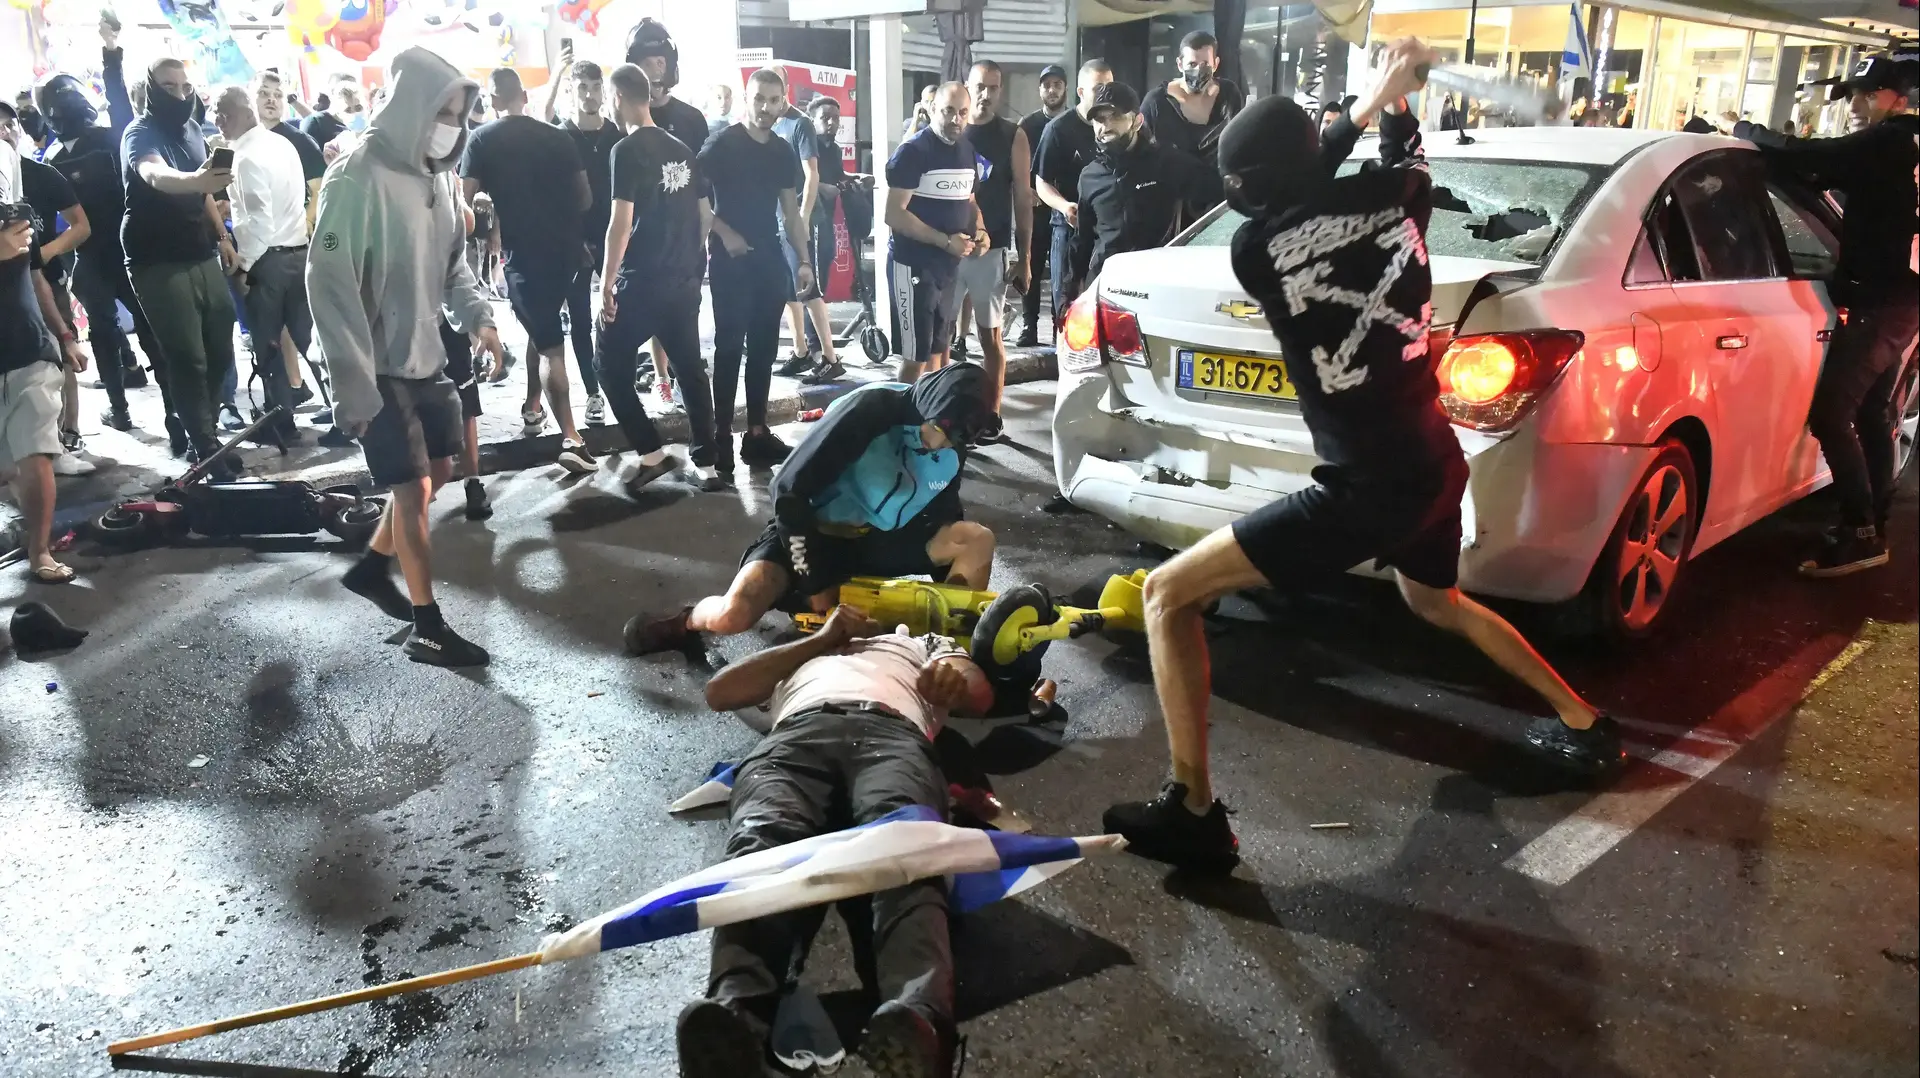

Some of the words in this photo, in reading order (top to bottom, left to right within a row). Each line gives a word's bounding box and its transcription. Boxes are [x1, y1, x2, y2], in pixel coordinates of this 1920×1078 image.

[817, 71, 838, 85] ATM
[936, 180, 973, 190] GANT
[900, 289, 909, 331] GANT
[1182, 362, 1191, 376] IL
[418, 637, 442, 651] adidas
